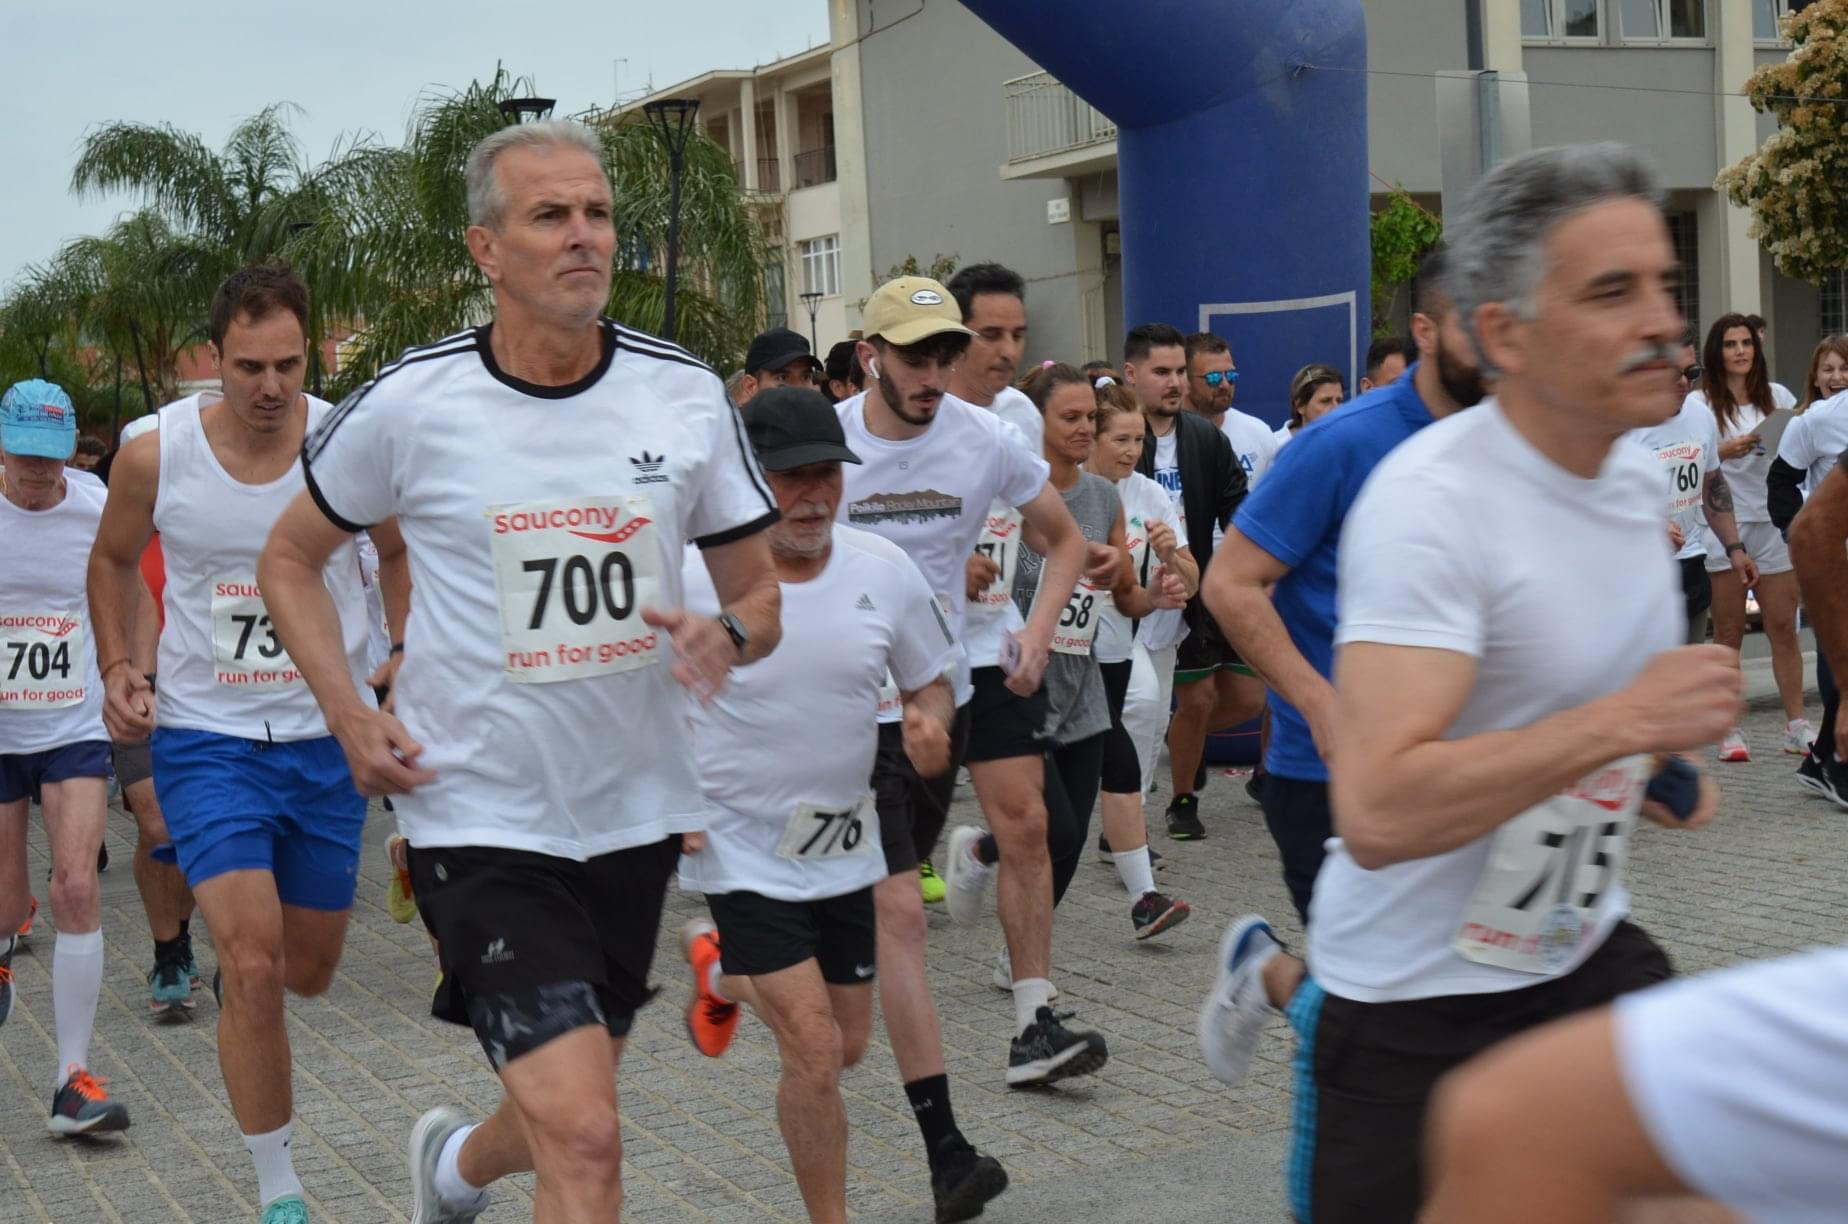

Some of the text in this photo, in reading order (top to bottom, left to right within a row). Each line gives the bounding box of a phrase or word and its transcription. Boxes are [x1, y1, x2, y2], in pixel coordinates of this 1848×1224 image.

[494, 507, 619, 534] saucony
[522, 551, 635, 630] 700
[1060, 592, 1094, 629] 58
[231, 614, 283, 660] 73
[508, 632, 657, 667] run for good
[7, 641, 71, 680] 704
[218, 671, 248, 683] run
[253, 669, 278, 682] for
[0, 687, 84, 702] un for good
